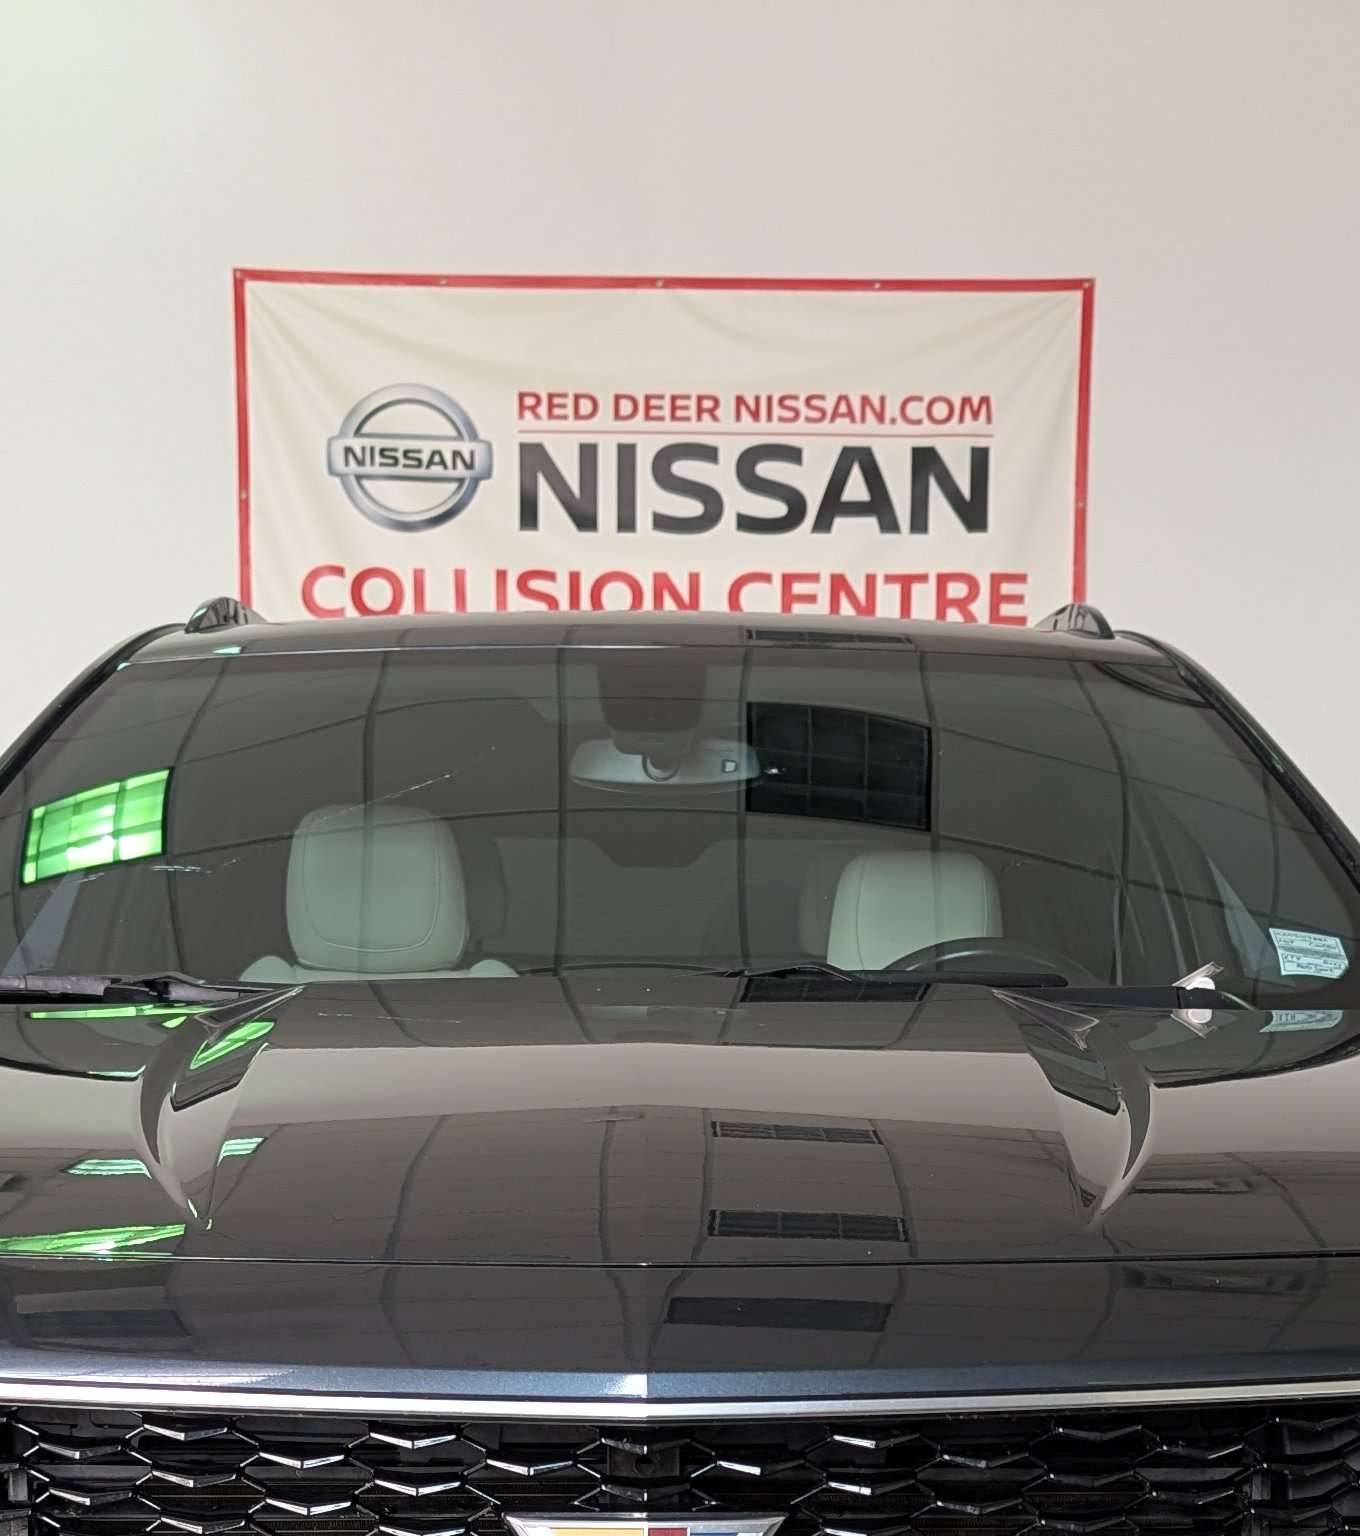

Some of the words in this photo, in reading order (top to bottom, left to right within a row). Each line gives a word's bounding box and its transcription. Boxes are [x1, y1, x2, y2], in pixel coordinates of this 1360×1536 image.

[517, 391, 599, 421] RED
[612, 394, 721, 423] DEER
[734, 395, 994, 426] NISSAN.COM
[343, 445, 476, 471] NISSAN
[518, 442, 990, 536] NISSAN
[727, 571, 1029, 627] CENTRE
